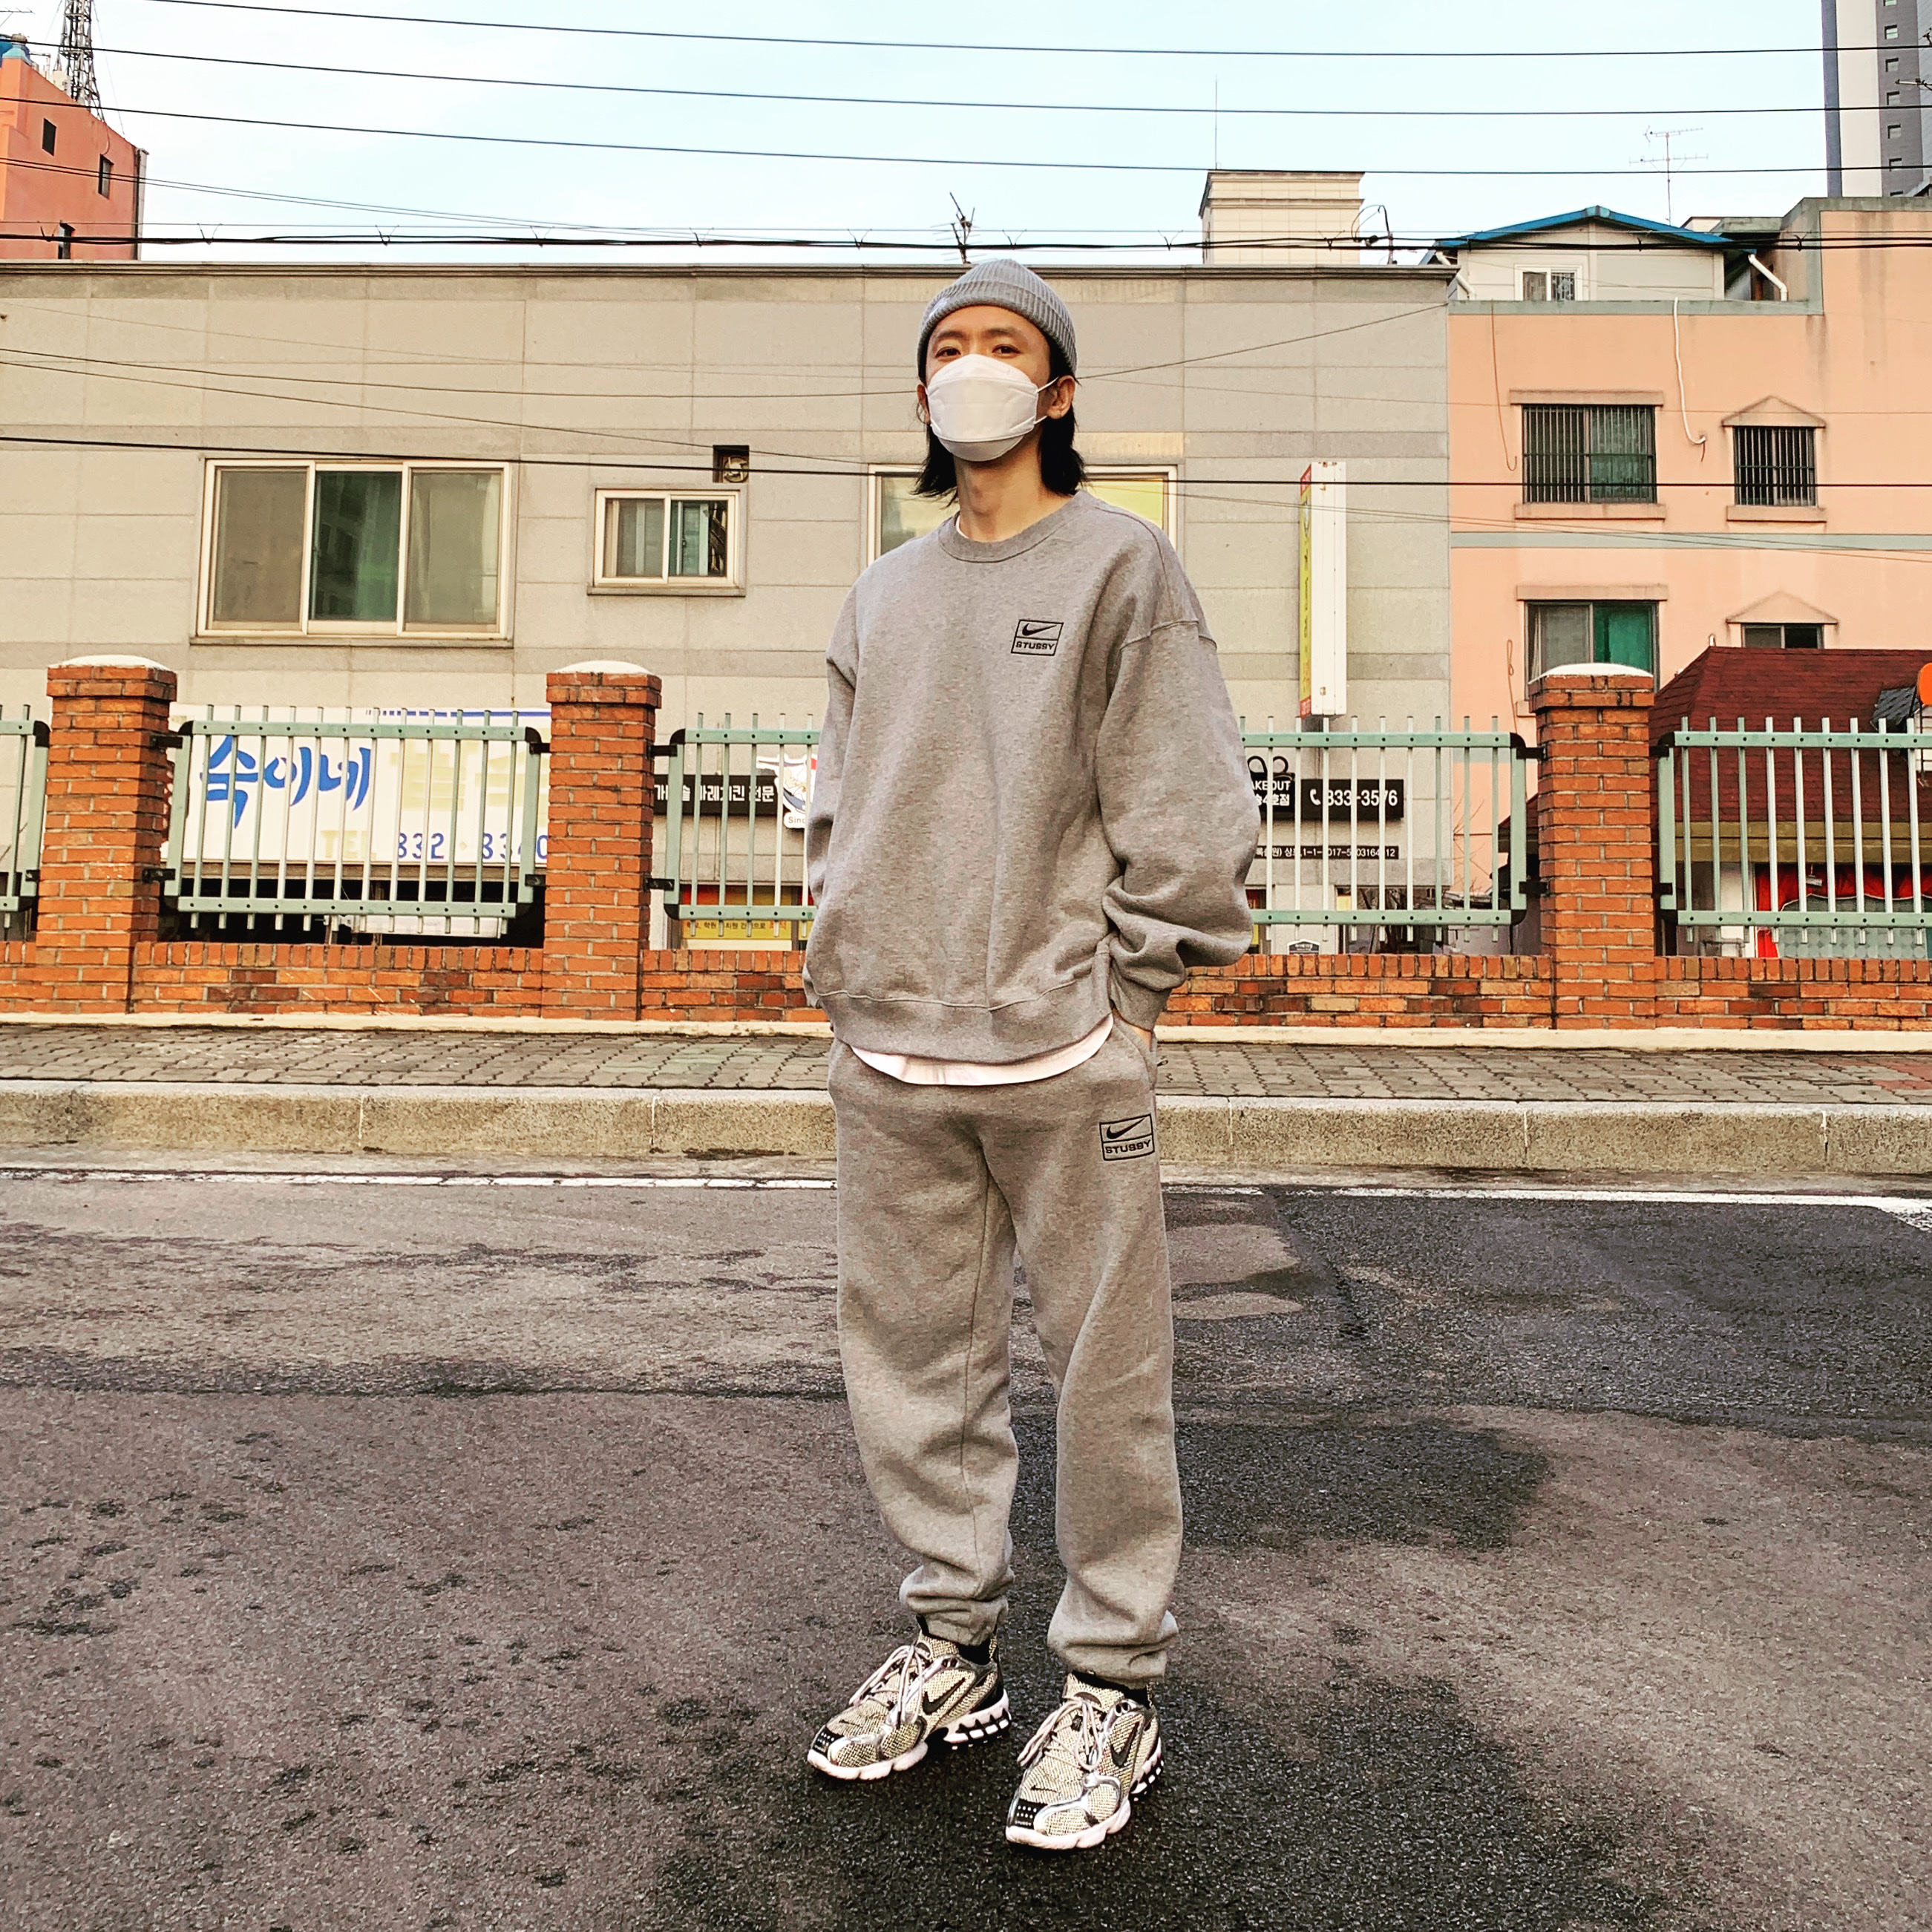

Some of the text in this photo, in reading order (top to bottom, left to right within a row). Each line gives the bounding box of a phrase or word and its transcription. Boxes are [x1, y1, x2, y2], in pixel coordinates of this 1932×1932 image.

[1015, 641, 1055, 650] STUSSY
[200, 735, 371, 829] 숙이네
[1105, 1139, 1150, 1154] STUSSY
